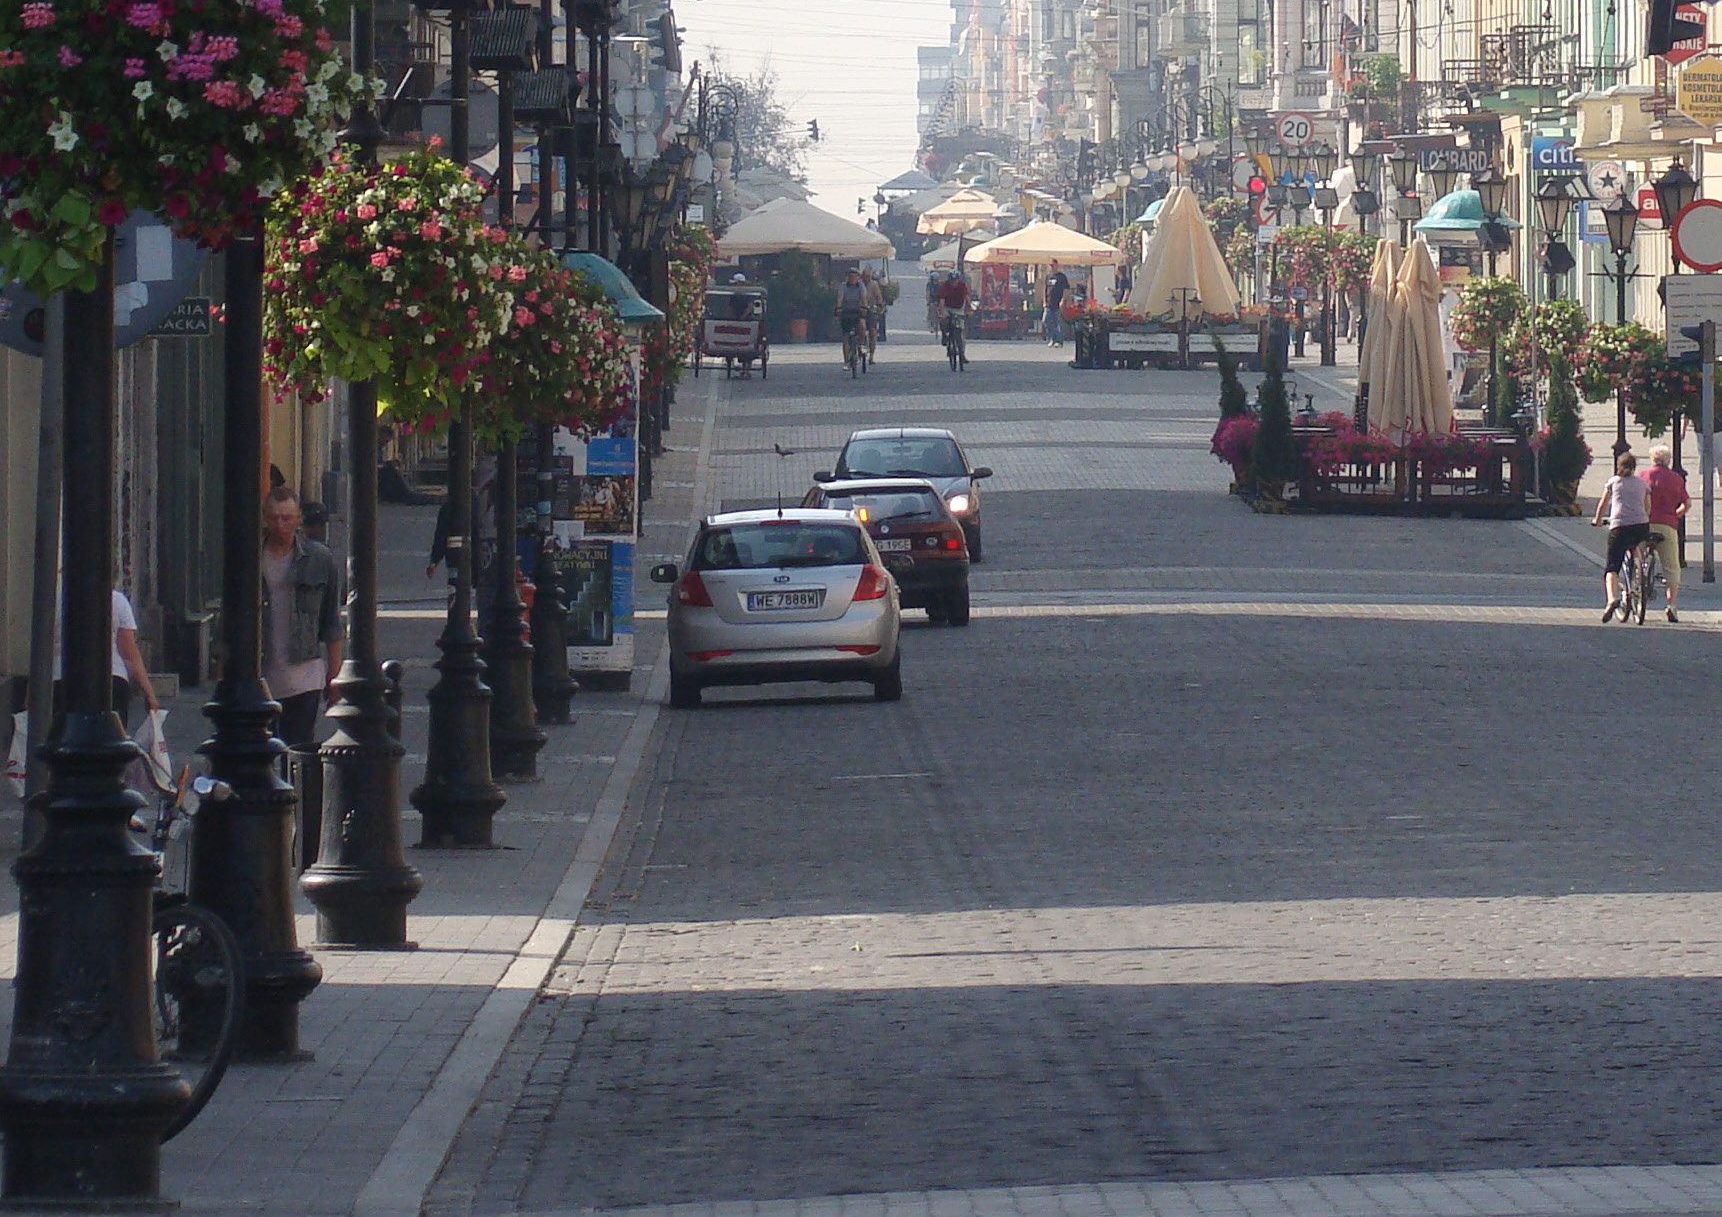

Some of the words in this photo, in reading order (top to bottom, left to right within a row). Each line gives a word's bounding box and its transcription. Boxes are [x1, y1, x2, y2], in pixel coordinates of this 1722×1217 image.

[1283, 120, 1308, 139] 20
[1539, 143, 1574, 164] citi
[172, 304, 204, 316] RIA
[159, 318, 206, 330] ACKA
[756, 594, 774, 607] WE
